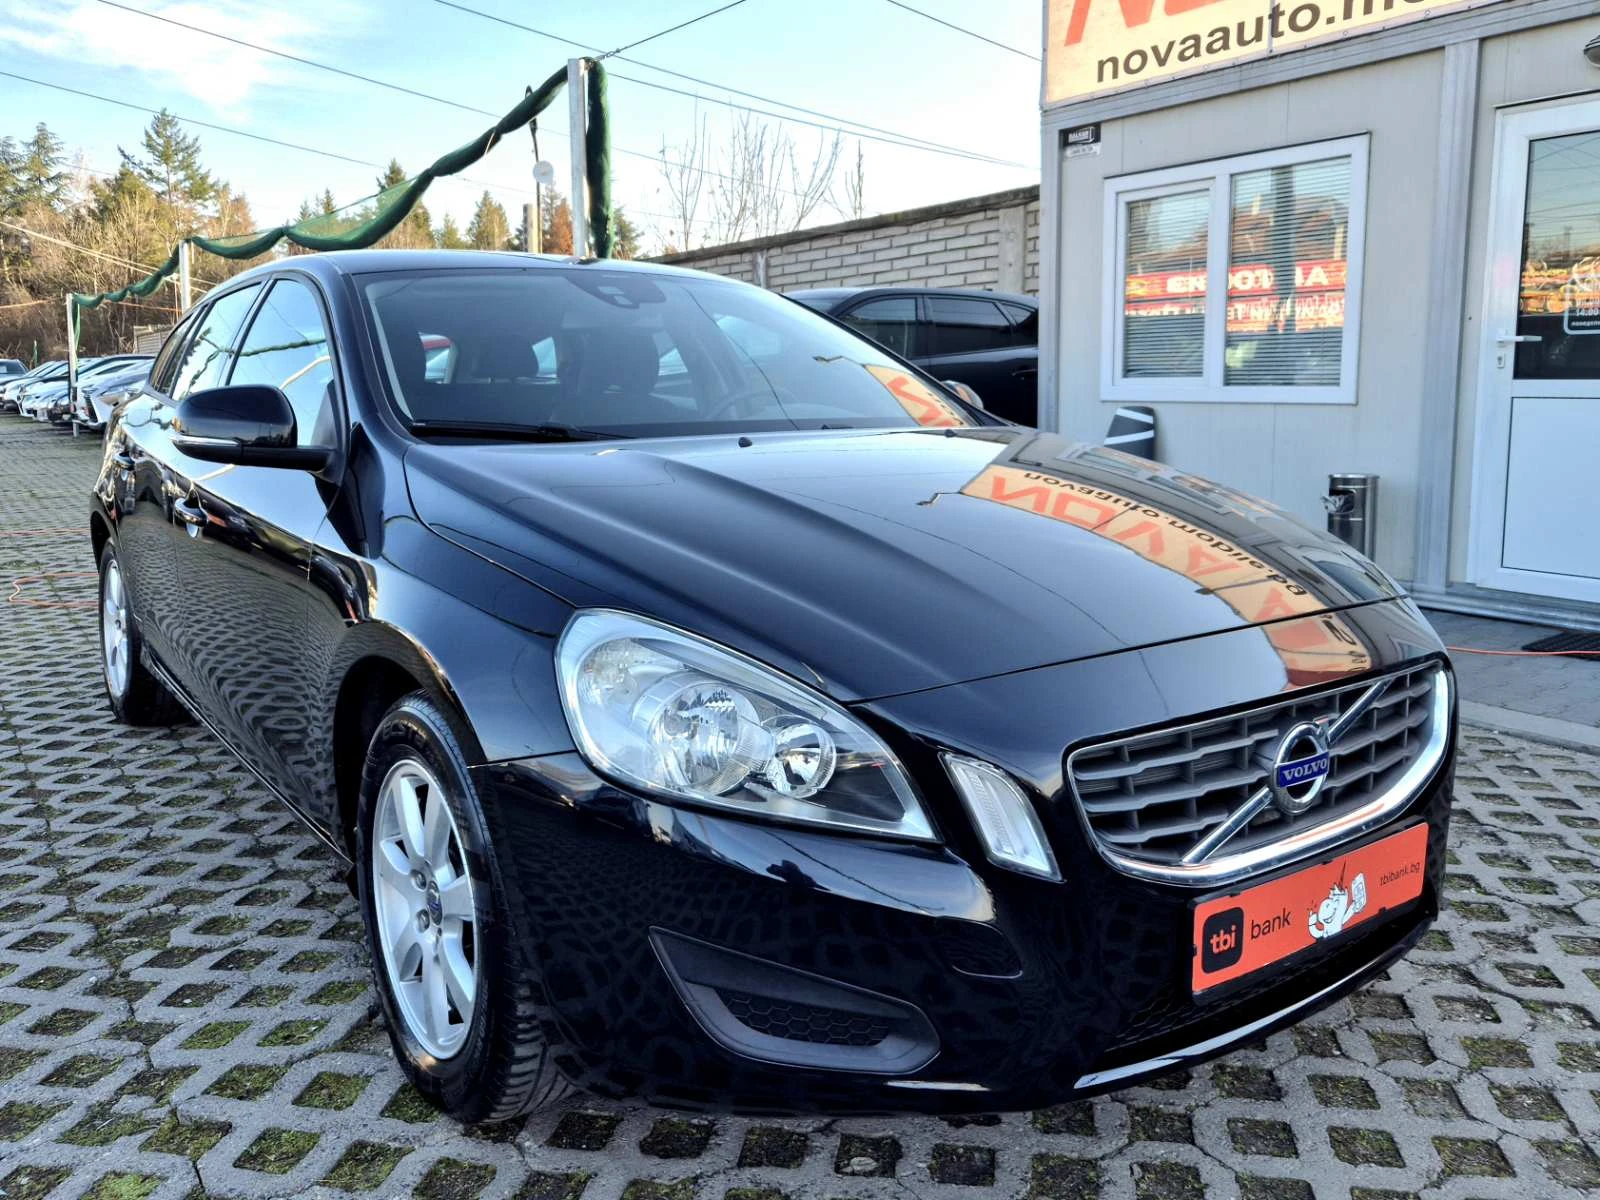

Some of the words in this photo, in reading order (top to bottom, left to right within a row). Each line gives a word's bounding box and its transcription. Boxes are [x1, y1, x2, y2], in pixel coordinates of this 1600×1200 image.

[1097, 0, 1425, 82] novaauto.m
[1283, 758, 1328, 781] VOLVO
[1379, 860, 1421, 887] tbibank.bg
[1209, 924, 1236, 955] tbi
[1249, 907, 1292, 941] bank
